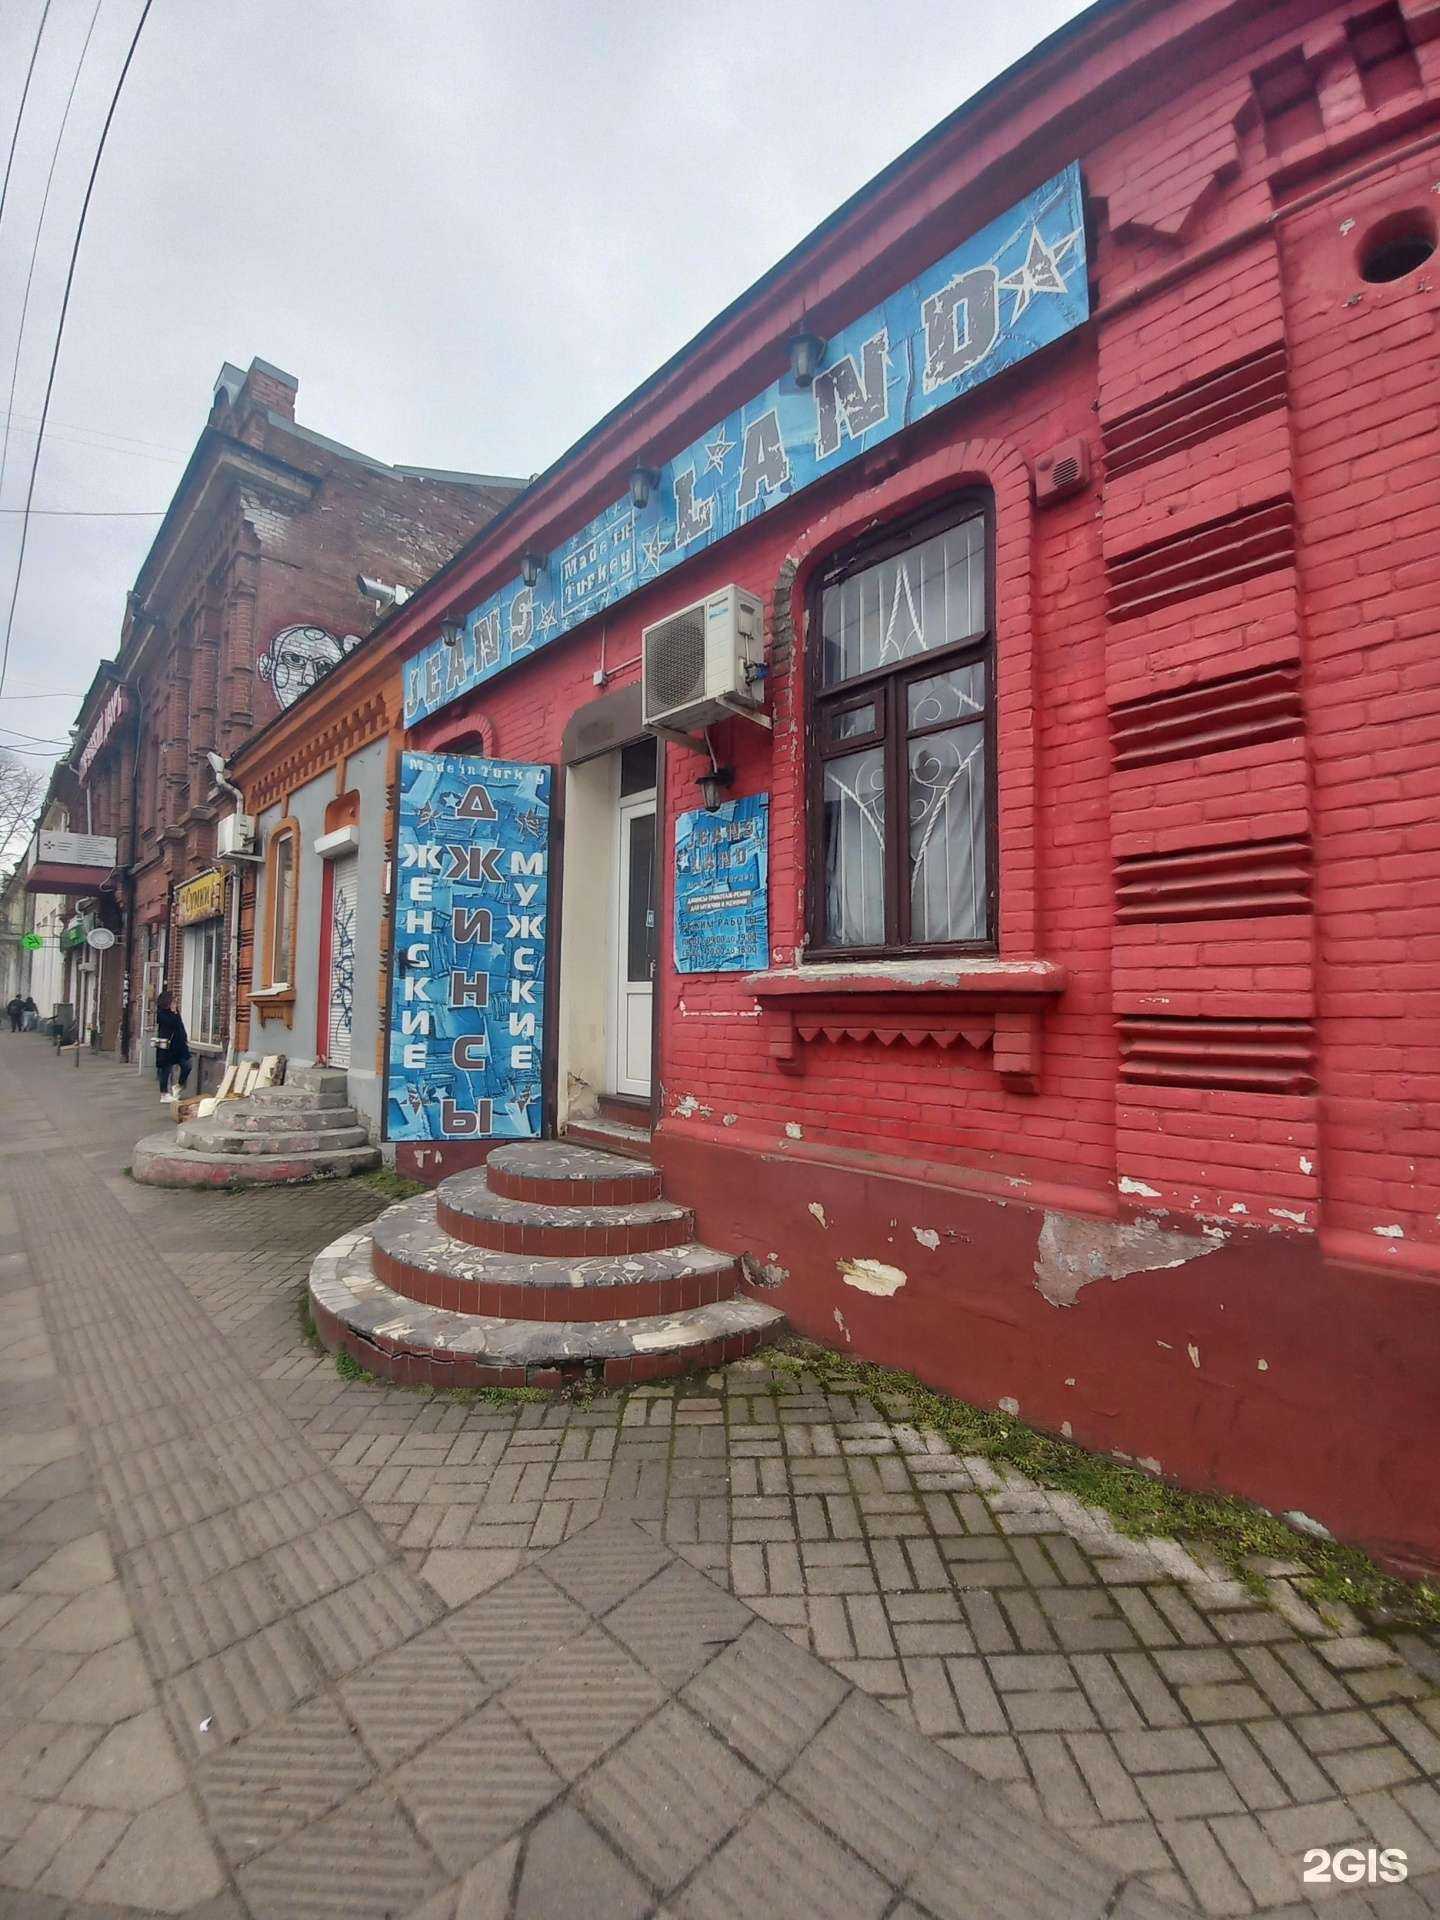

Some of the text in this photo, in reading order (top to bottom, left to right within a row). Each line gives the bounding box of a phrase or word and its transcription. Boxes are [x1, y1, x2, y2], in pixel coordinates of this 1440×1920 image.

[404, 264, 1000, 719] JEANS LAND
[564, 543, 608, 581] Made
[565, 549, 631, 603] Turkey
[409, 758, 545, 785] Made in Turkey
[687, 819, 755, 849] JEANS
[690, 846, 748, 873] LAND
[400, 844, 442, 1070] ЖЕНСКИЕ
[440, 783, 507, 1137] ДЖИНСЫ
[505, 850, 545, 1070] МУЖСКИЕ
